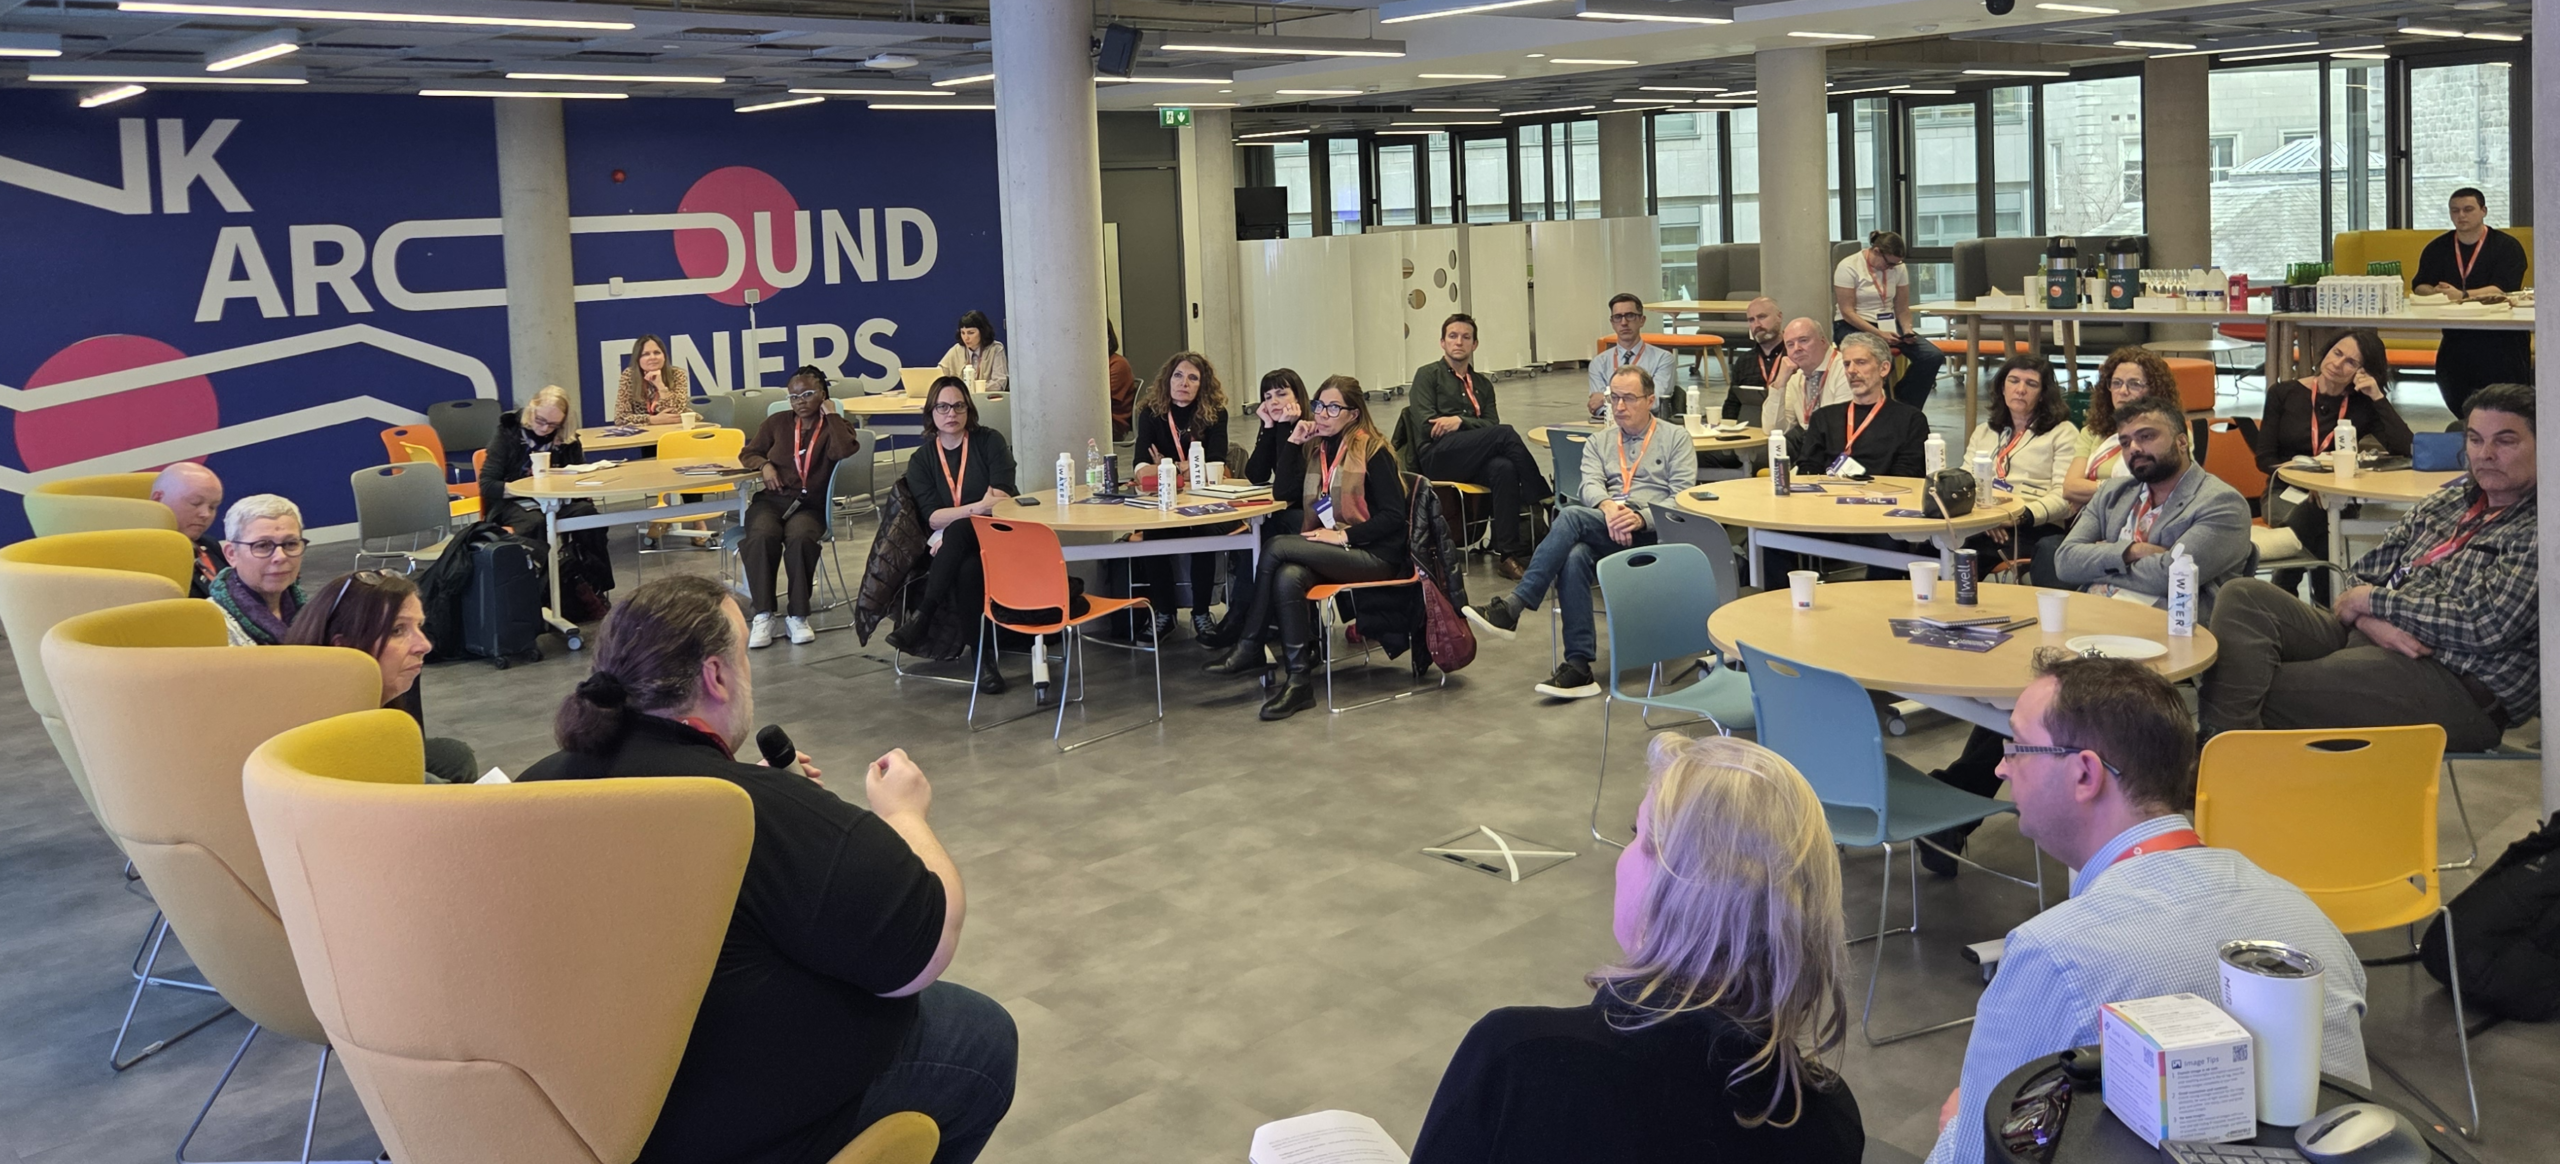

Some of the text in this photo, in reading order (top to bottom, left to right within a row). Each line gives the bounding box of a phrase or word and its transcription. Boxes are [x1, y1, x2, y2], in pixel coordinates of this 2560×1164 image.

[2176, 578, 2186, 626] WATER
[2184, 1056, 2220, 1067] Image Tips
